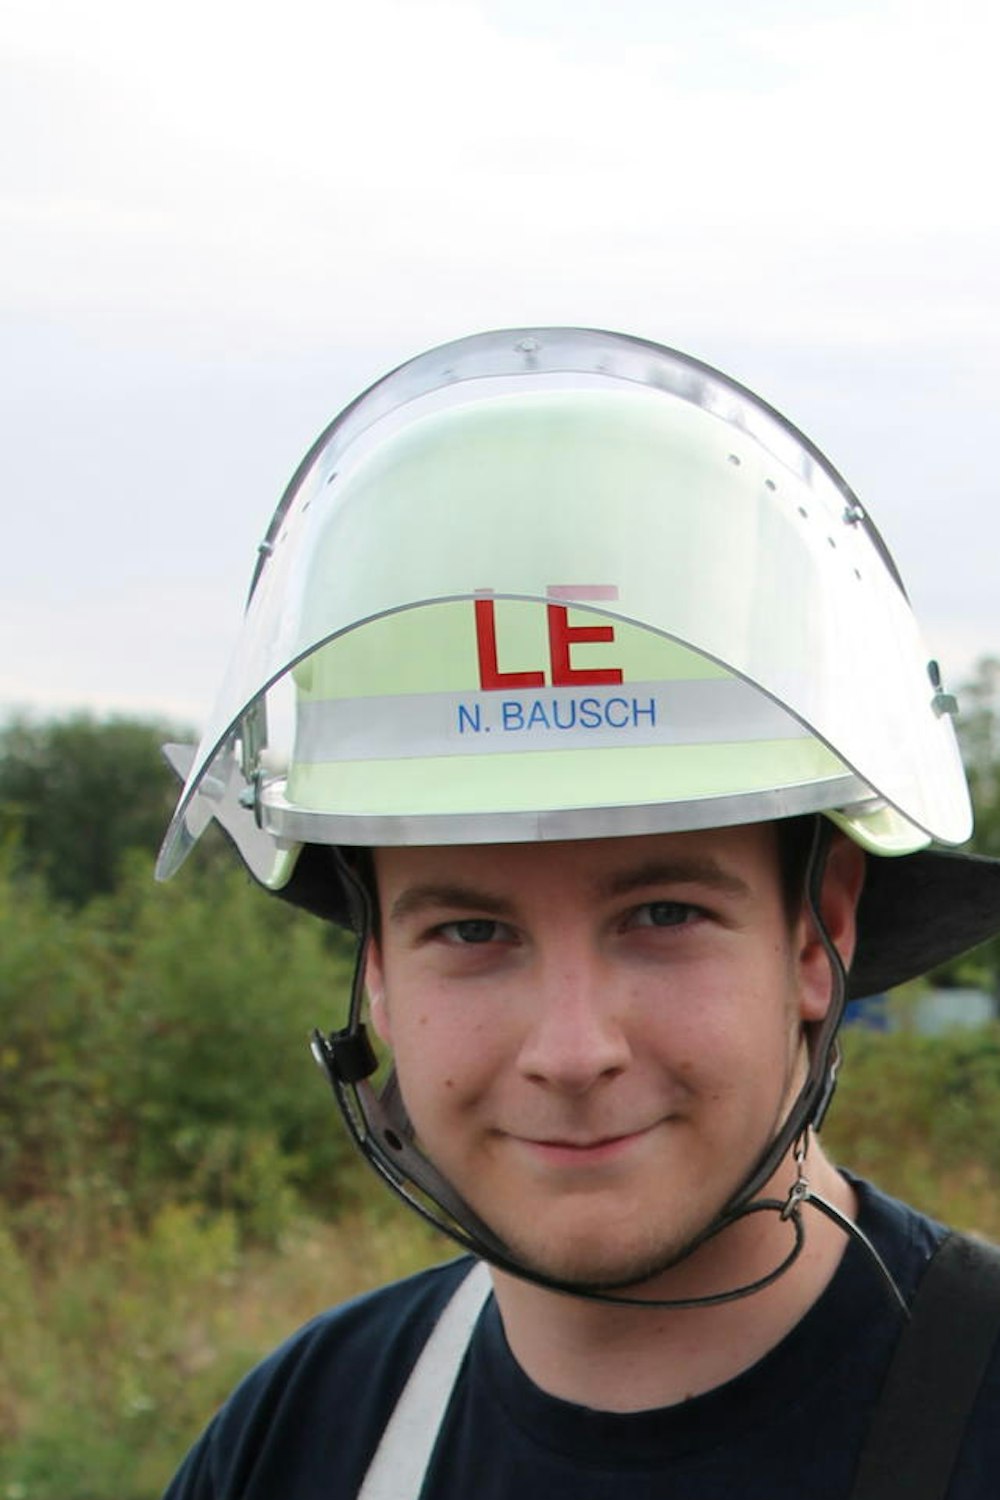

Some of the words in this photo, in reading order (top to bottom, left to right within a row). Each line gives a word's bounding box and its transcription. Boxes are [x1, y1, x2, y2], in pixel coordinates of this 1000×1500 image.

[474, 585, 623, 691] LE
[458, 704, 491, 733] N.
[502, 698, 656, 731] BAUSCH
